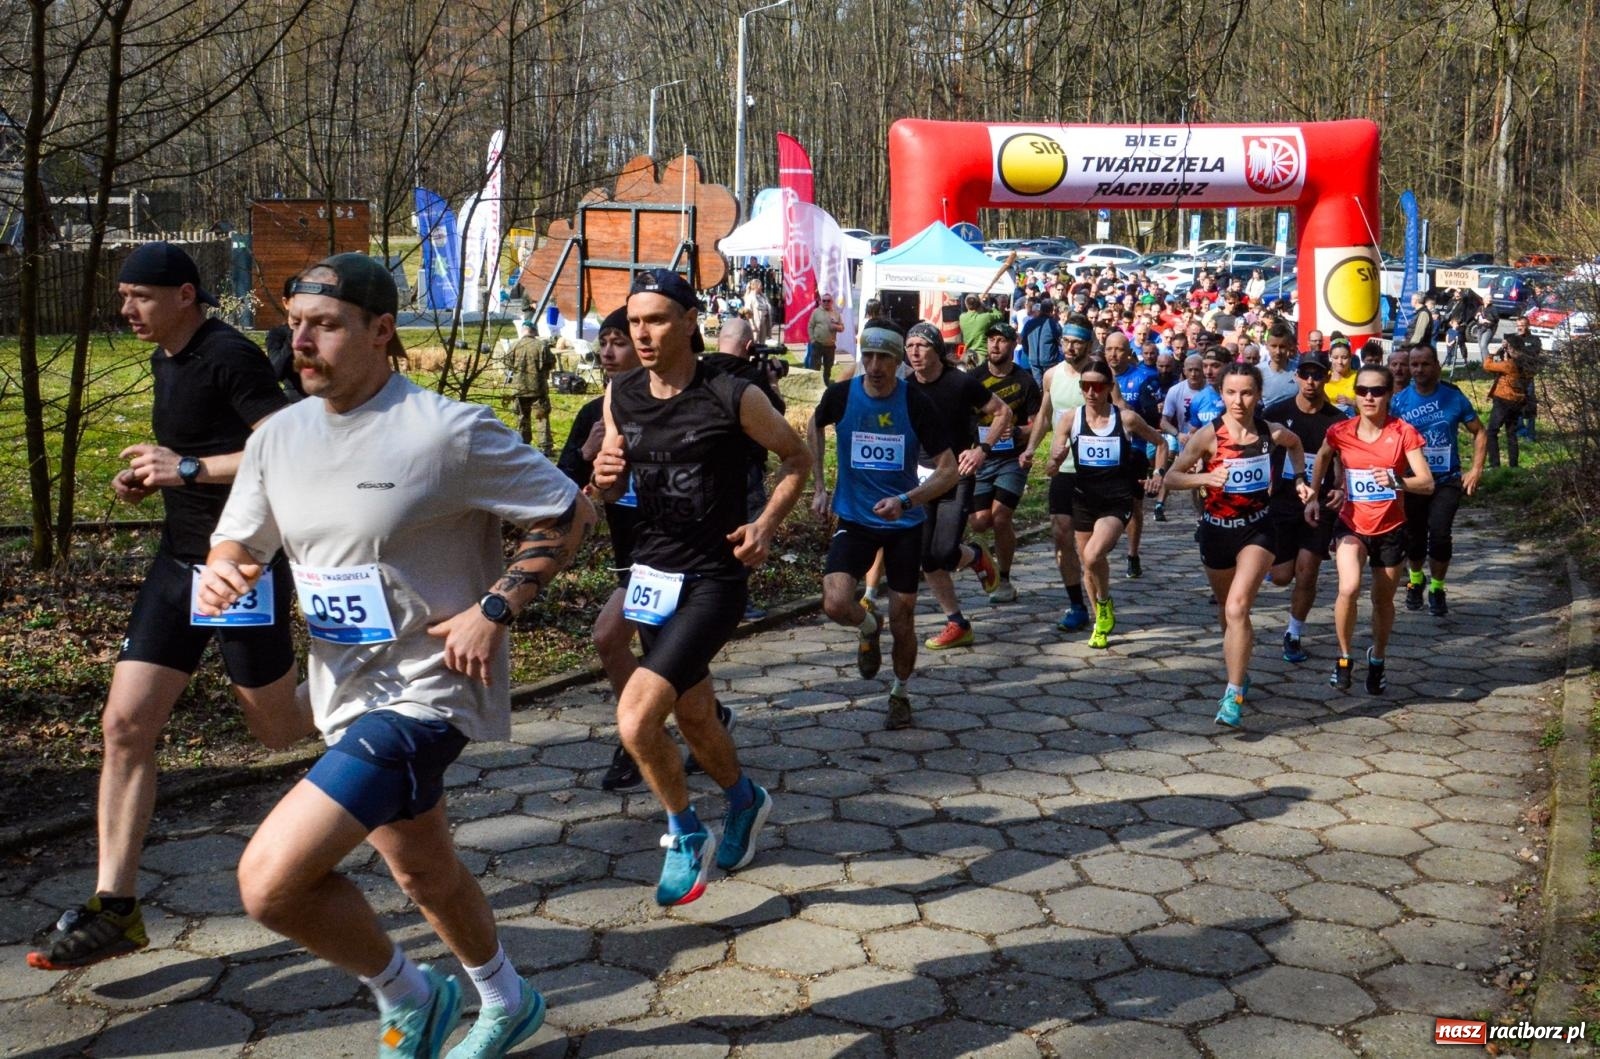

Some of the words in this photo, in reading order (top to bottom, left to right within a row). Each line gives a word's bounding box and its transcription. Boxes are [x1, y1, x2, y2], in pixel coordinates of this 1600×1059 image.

[1125, 134, 1178, 147] BIEG
[1082, 156, 1225, 172] TWARDZIELA
[1096, 178, 1210, 196] RACIBÓRZ
[1444, 271, 1469, 280] VAMOS
[1401, 400, 1440, 420] MORSY
[860, 445, 895, 461] 003
[1086, 447, 1110, 458] 031
[1232, 468, 1263, 483] 090
[632, 584, 662, 609] 051
[311, 593, 367, 624] 055
